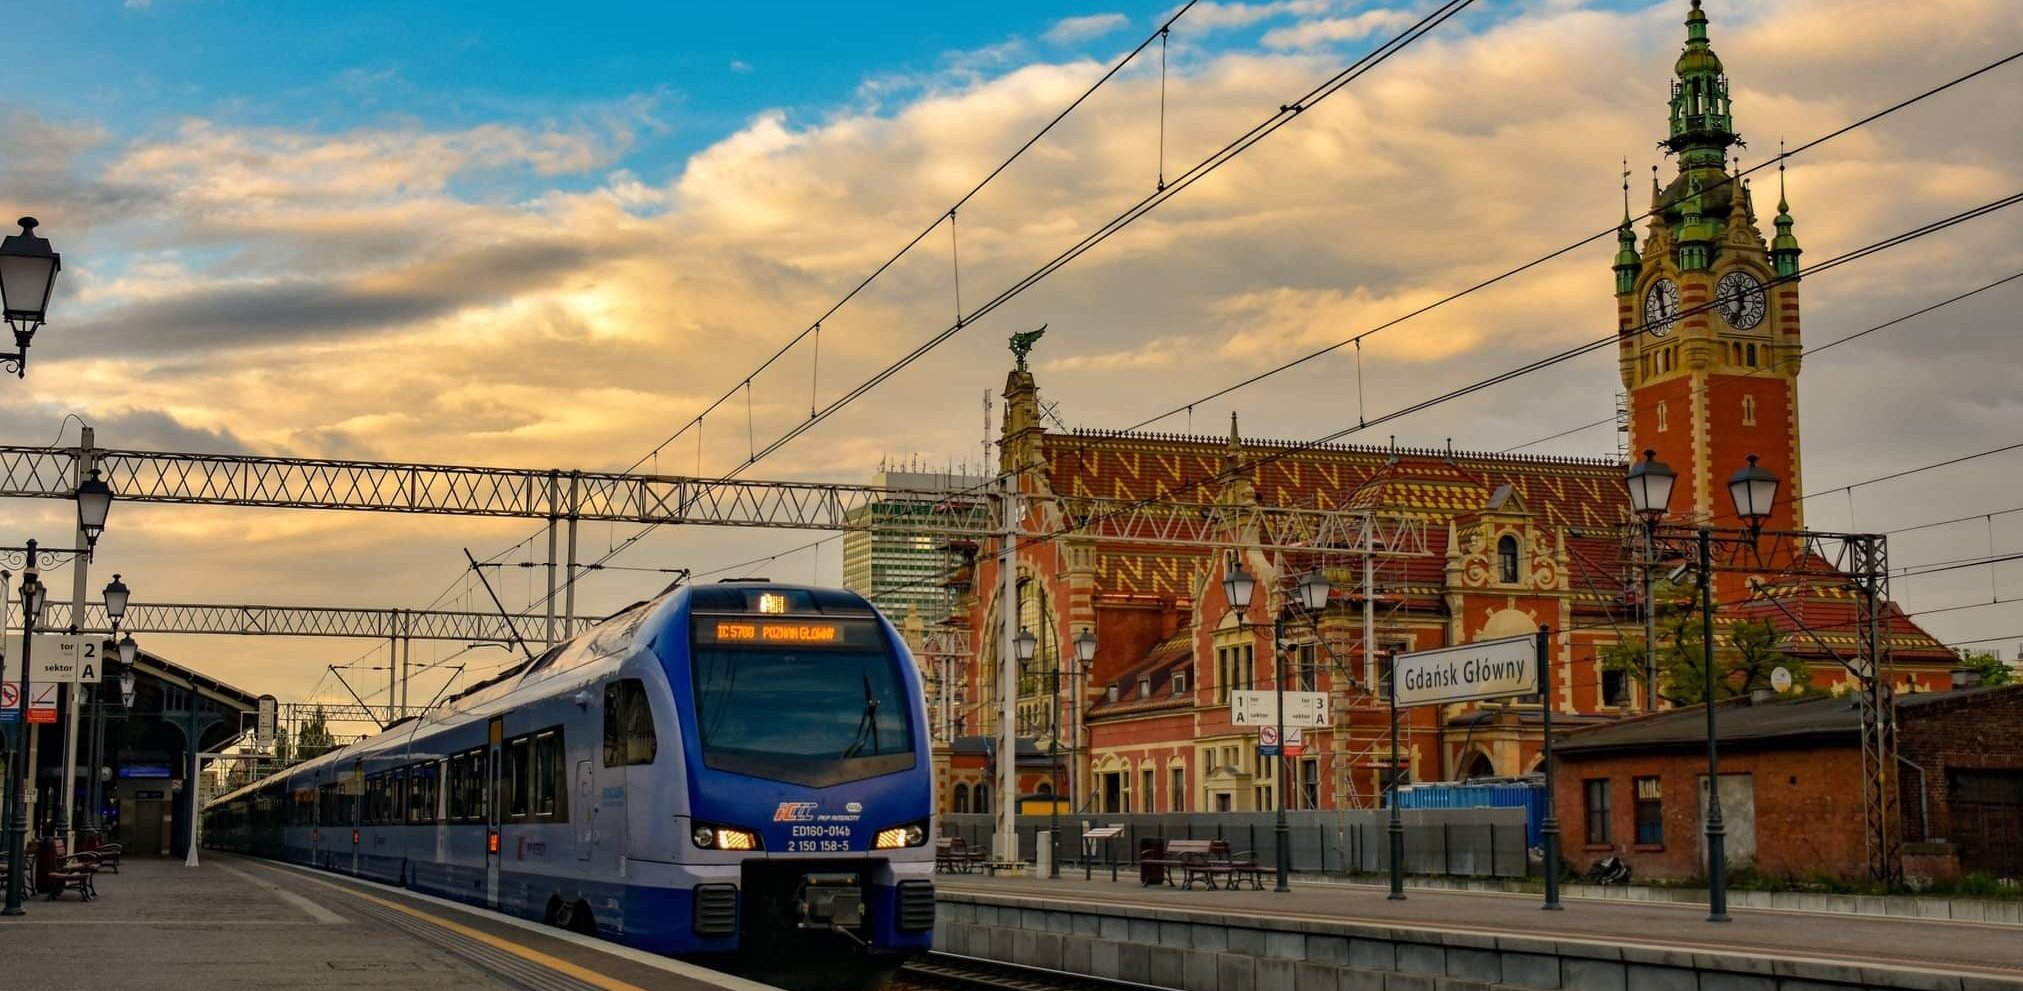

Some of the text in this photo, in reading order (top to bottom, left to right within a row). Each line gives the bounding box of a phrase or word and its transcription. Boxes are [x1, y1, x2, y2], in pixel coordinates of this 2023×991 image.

[84, 643, 95, 658] 2
[44, 663, 95, 678] sektor A
[1405, 657, 1525, 690] Gdańsk Główny
[1237, 696, 1243, 707] 1
[1316, 698, 1323, 709] 3
[1236, 712, 1244, 723] A
[1316, 714, 1324, 724] A
[788, 840, 849, 851] 2 150 158-5
